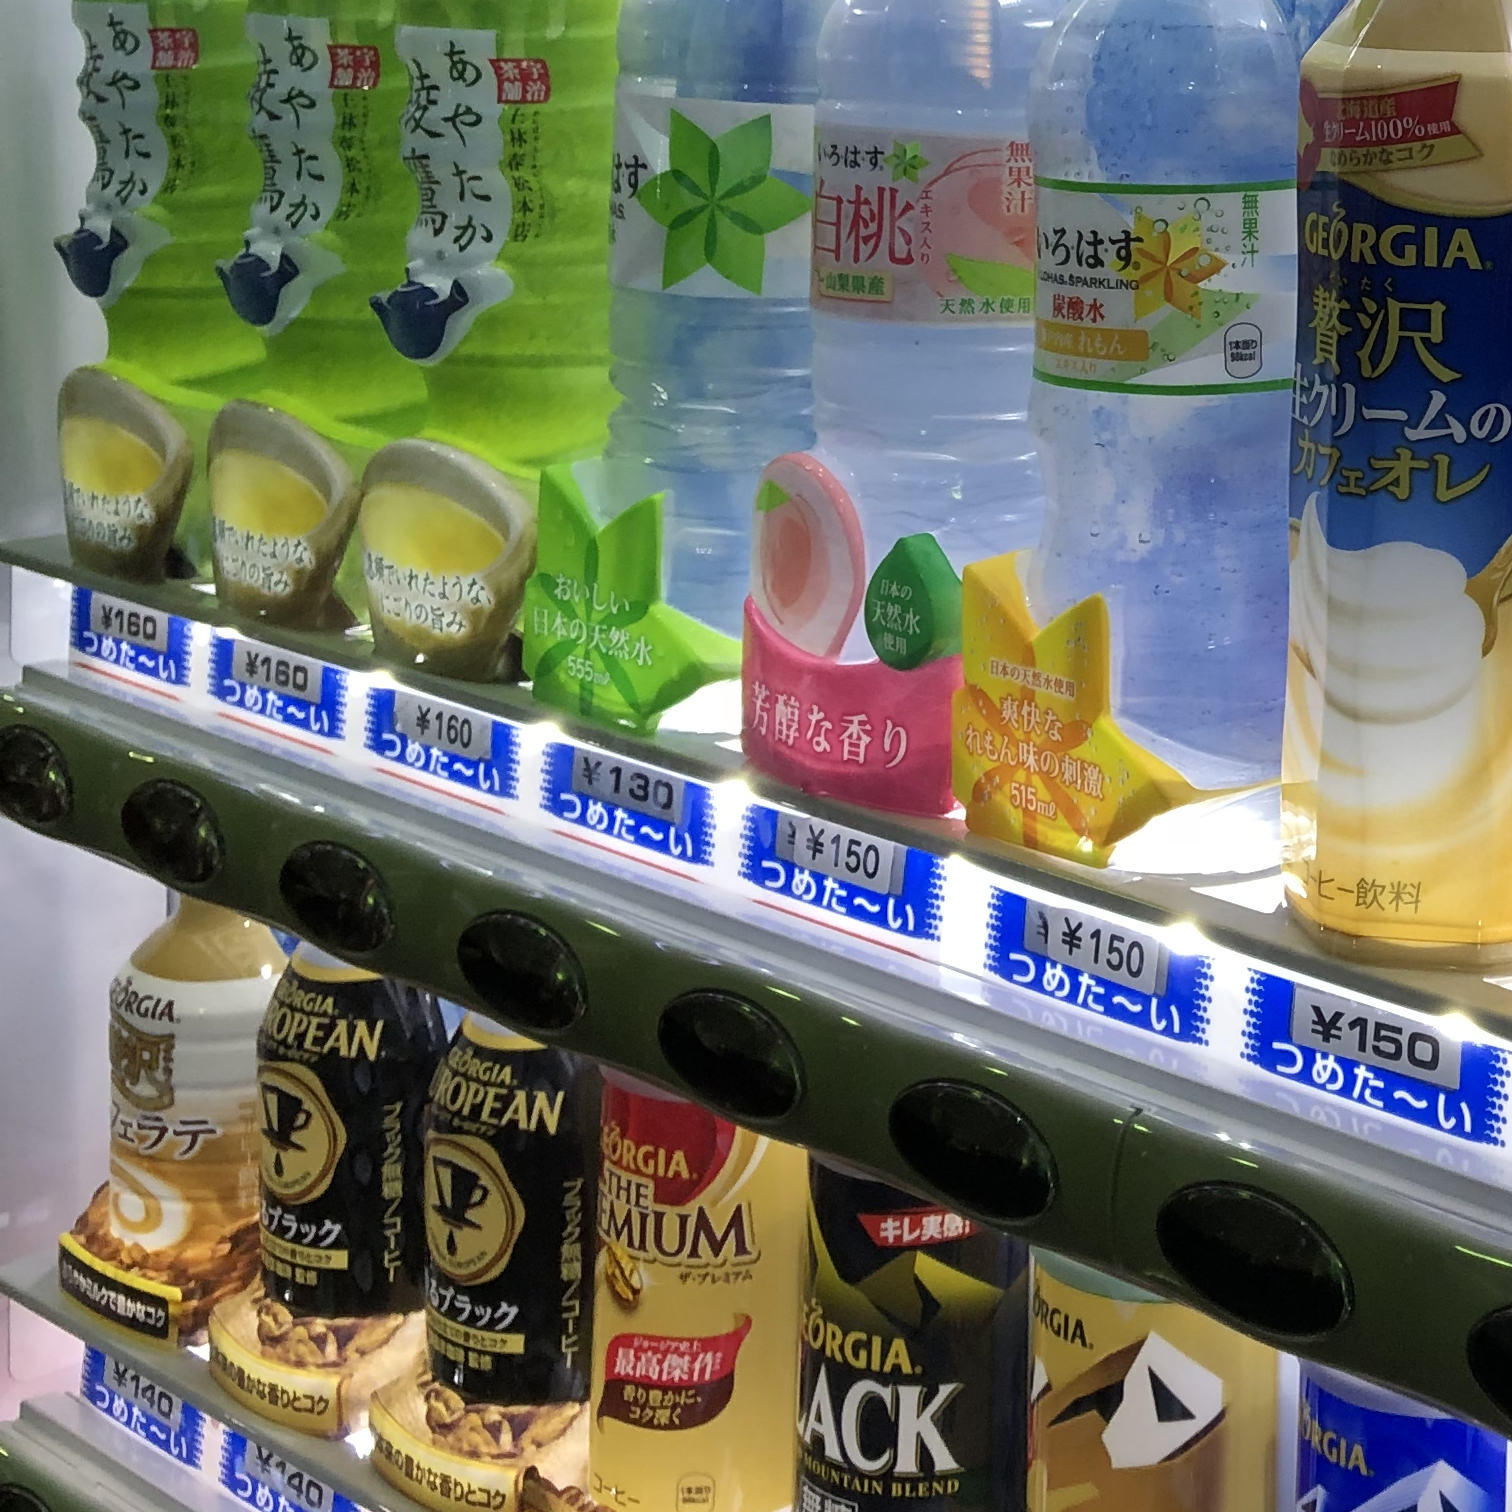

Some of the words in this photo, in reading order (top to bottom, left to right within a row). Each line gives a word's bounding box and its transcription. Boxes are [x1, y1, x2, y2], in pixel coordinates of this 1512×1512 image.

[105, 13, 153, 206] あやたか
[280, 28, 325, 229] あやたか
[444, 40, 493, 253] あやたか
[1005, 140, 1034, 214] 無果汁
[814, 176, 916, 266] 白桃
[919, 189, 934, 265] エキス入り
[1241, 193, 1260, 268] 無果汁
[1305, 202, 1484, 270] GEORGIA
[826, 273, 886, 296] 山梨県産
[940, 297, 1032, 315] 天然水使用
[1052, 293, 1105, 324] 炭酸水
[1068, 273, 1140, 291] SPARKLING
[1310, 284, 1463, 383] 贅沢
[1292, 429, 1493, 504] カフェオレ
[553, 574, 630, 615] おいしい
[879, 578, 914, 601] 日本の
[101, 603, 157, 642] ¥160
[533, 607, 655, 667] 日本の天然水
[871, 599, 921, 636] 天然水
[882, 632, 908, 656] 使用
[245, 650, 309, 693] ¥160
[989, 658, 1076, 699] 日本の天然水使用
[416, 705, 473, 748] ¥160
[751, 681, 909, 769] 芳醇な香り
[999, 695, 1065, 744] 爽快な
[582, 756, 674, 811] ¥130
[965, 723, 1106, 801] れもん味の刺激
[805, 824, 880, 880] ¥150
[1060, 917, 1144, 979] ¥150
[1311, 1004, 1440, 1072] ¥150
[605, 1171, 651, 1211] THE
[112, 1359, 174, 1420] ¥140
[614, 1347, 723, 1383] 最高傑作
[891, 1477, 960, 1498] BLEND
